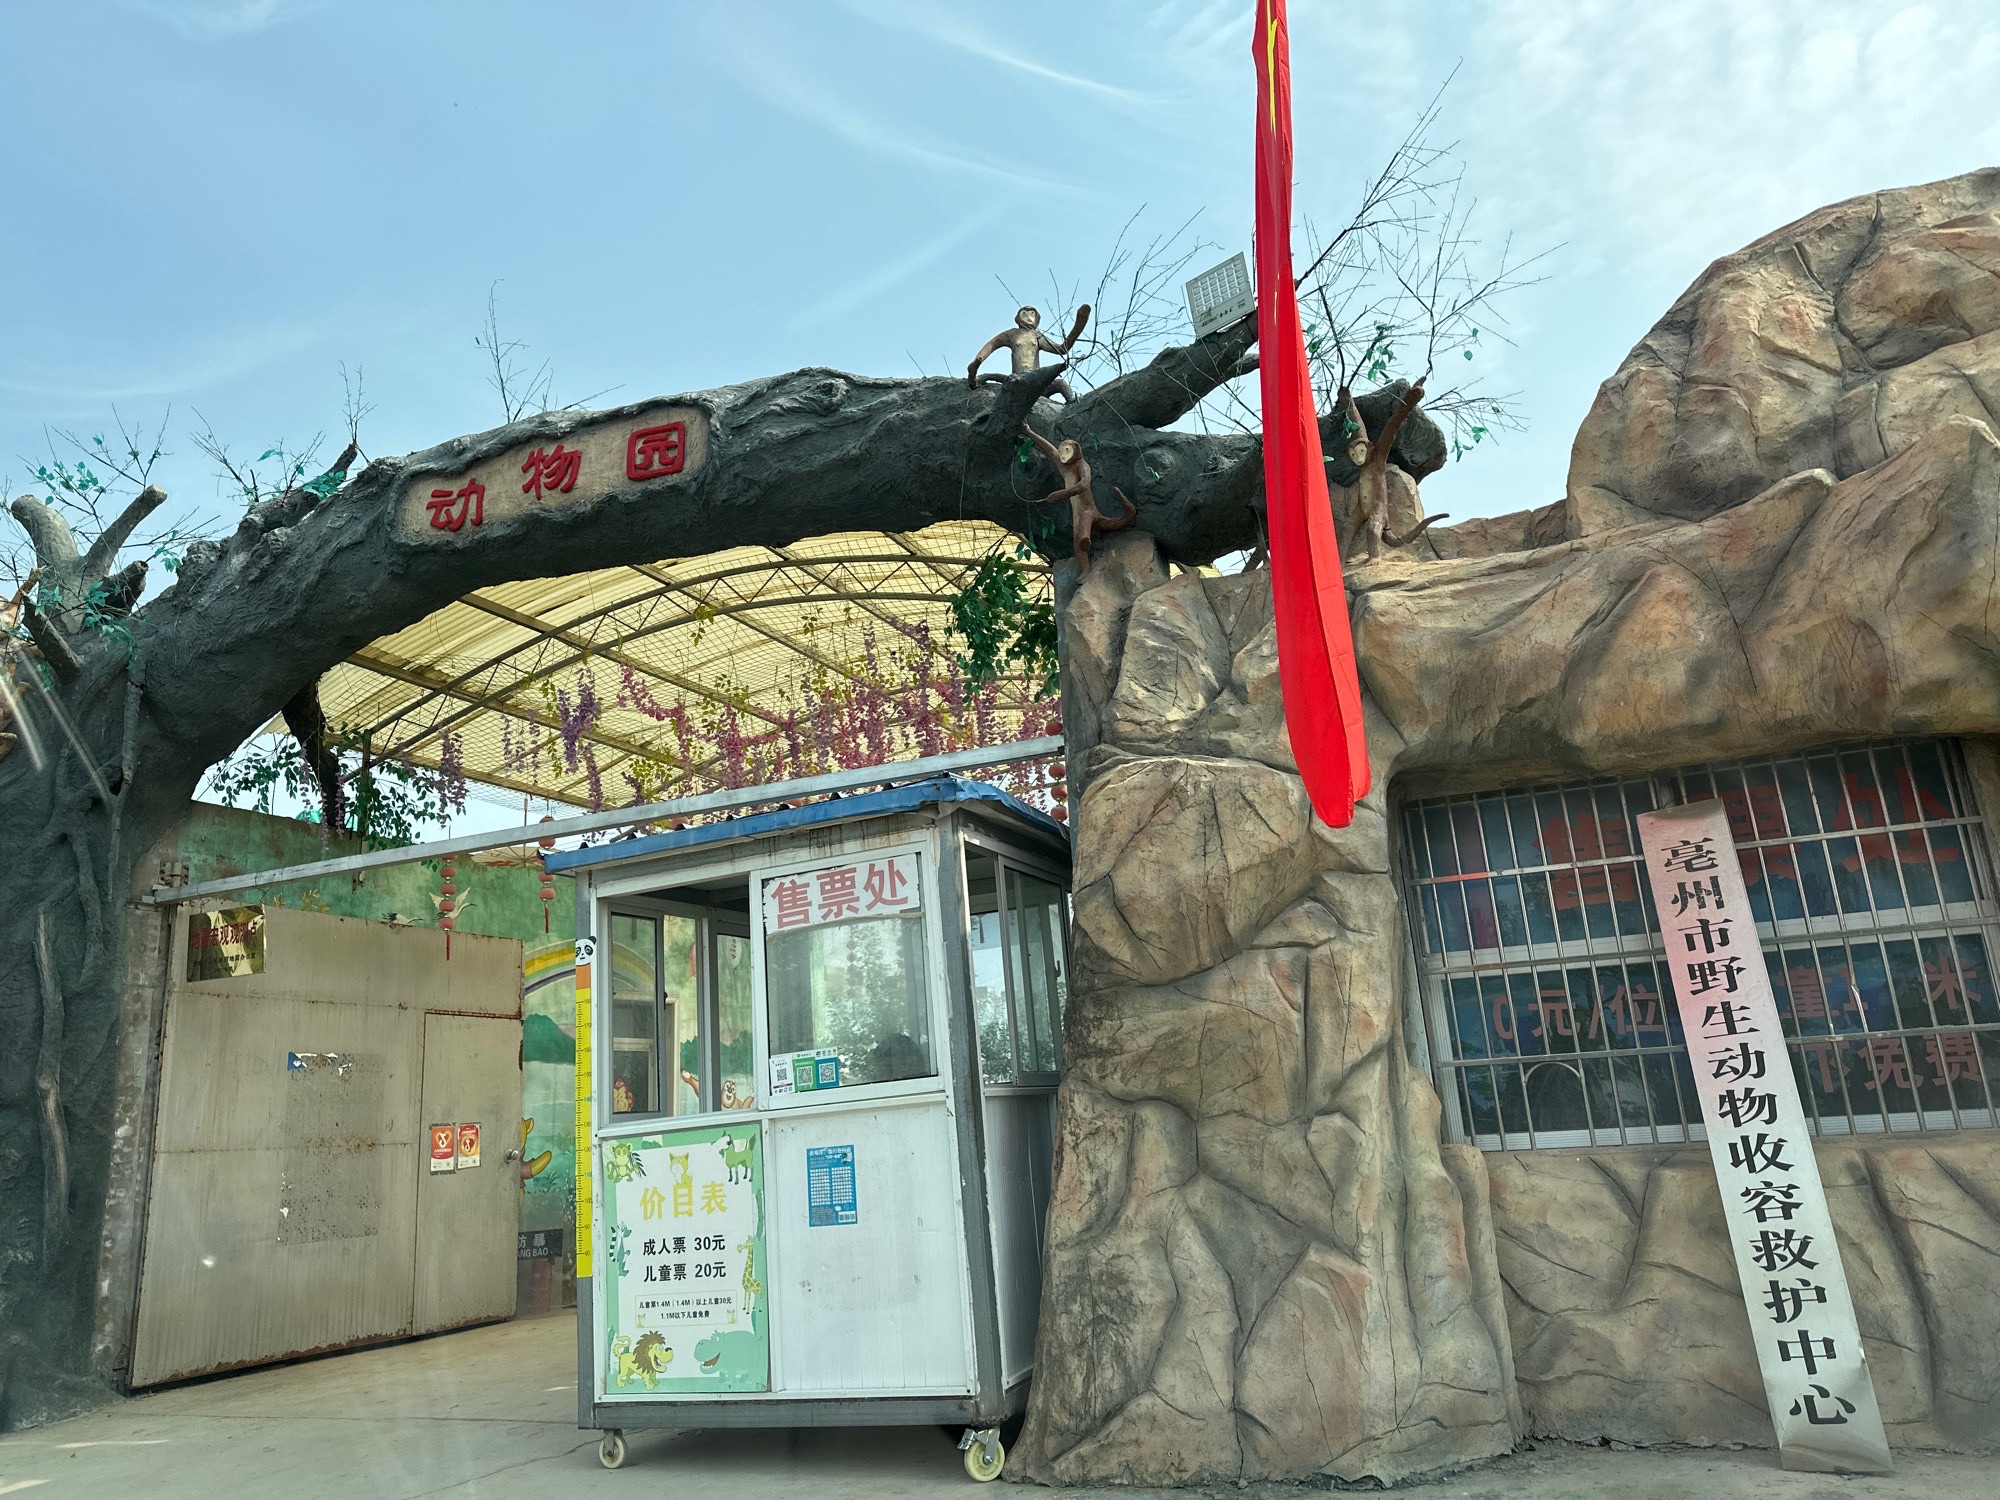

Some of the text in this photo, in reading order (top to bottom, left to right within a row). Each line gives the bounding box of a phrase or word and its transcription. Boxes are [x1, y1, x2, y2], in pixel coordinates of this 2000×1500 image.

[426, 421, 686, 532] 动物园
[772, 859, 909, 929] 售票处
[1660, 837, 1857, 1425] 亳州市野生动物收容救护中心
[640, 1181, 727, 1221] 价目表
[532, 1247, 548, 1257] BAO
[643, 1235, 725, 1256] 成人票 30元
[643, 1261, 726, 1282] 儿童票 20元
